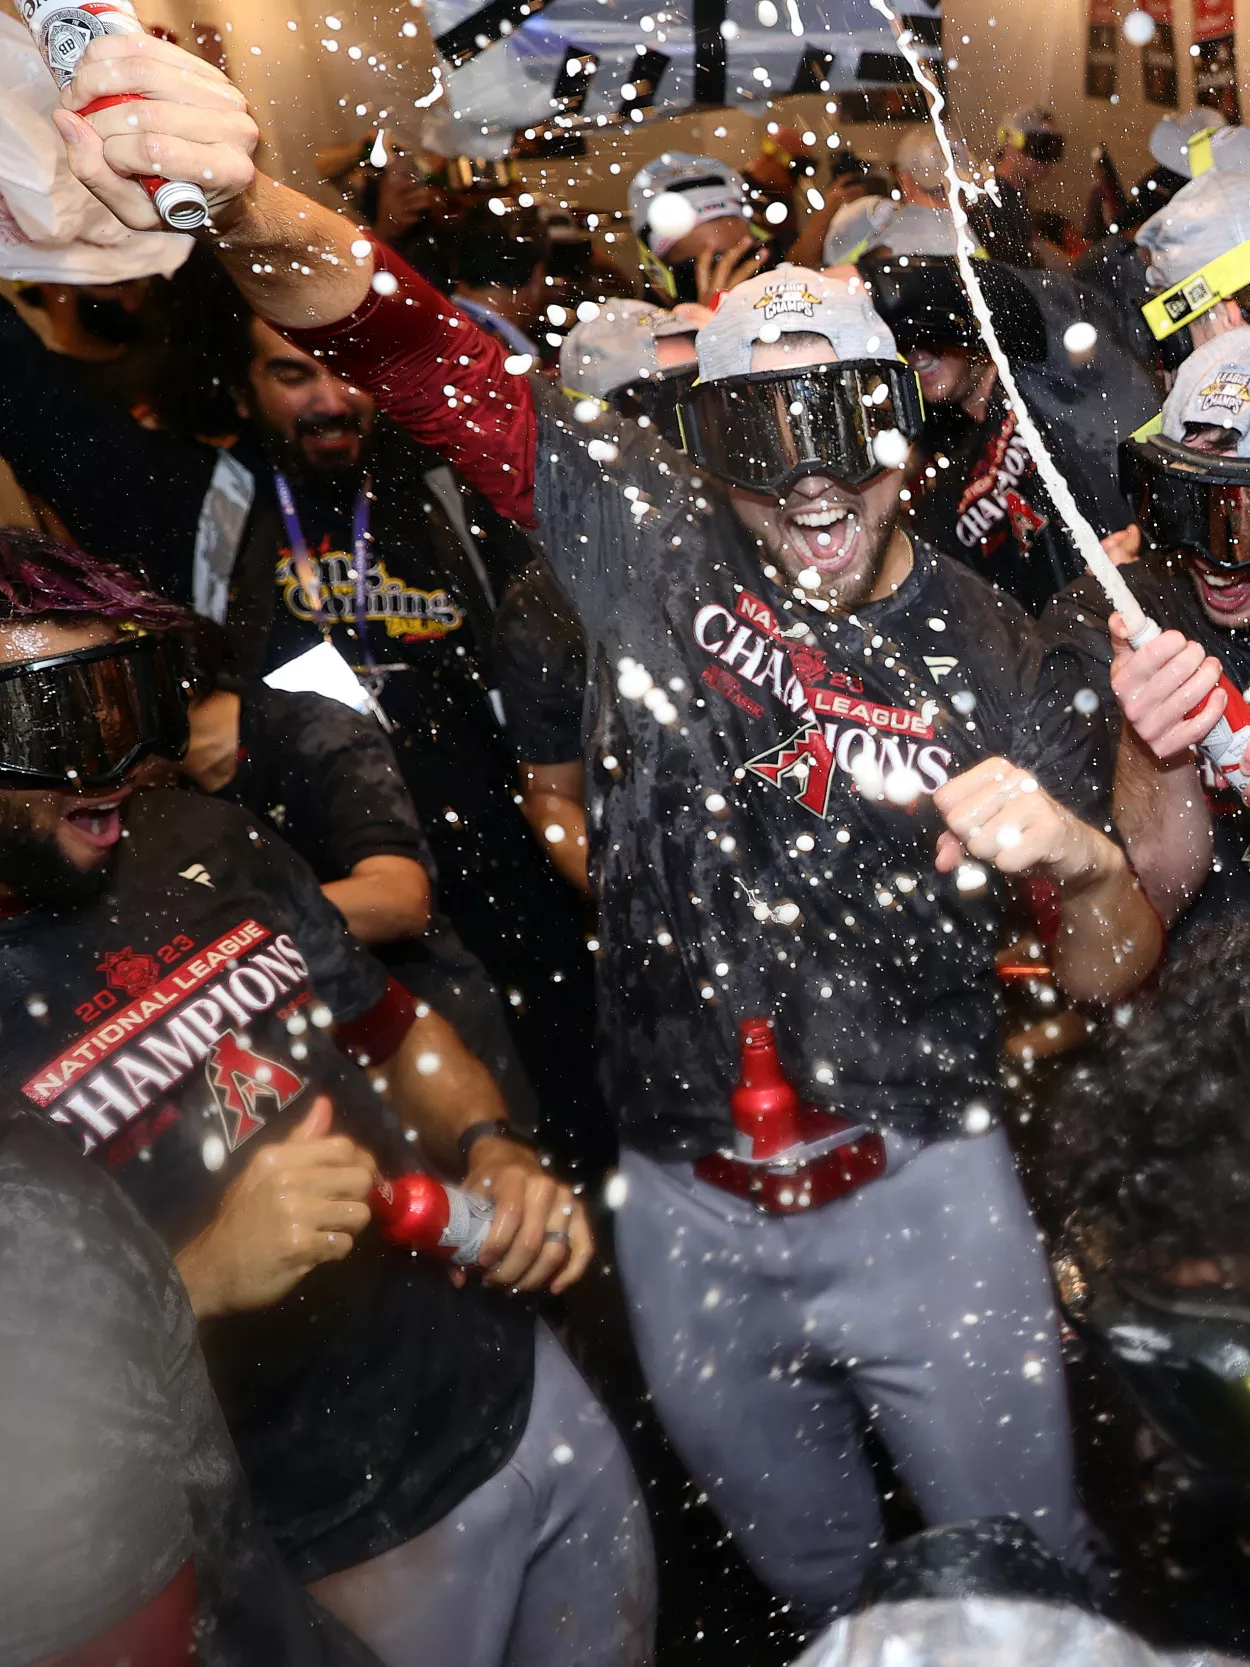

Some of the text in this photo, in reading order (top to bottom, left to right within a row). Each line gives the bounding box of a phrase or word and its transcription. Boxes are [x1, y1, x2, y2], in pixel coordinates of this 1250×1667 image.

[764, 300, 814, 320] CHAMPS
[1201, 393, 1244, 415] CHAMPS
[693, 603, 952, 796] CHAIONS
[815, 692, 929, 735] LEAGUE
[32, 920, 266, 1097] NATIONAL LEAGUE
[75, 933, 196, 1023] 20 23
